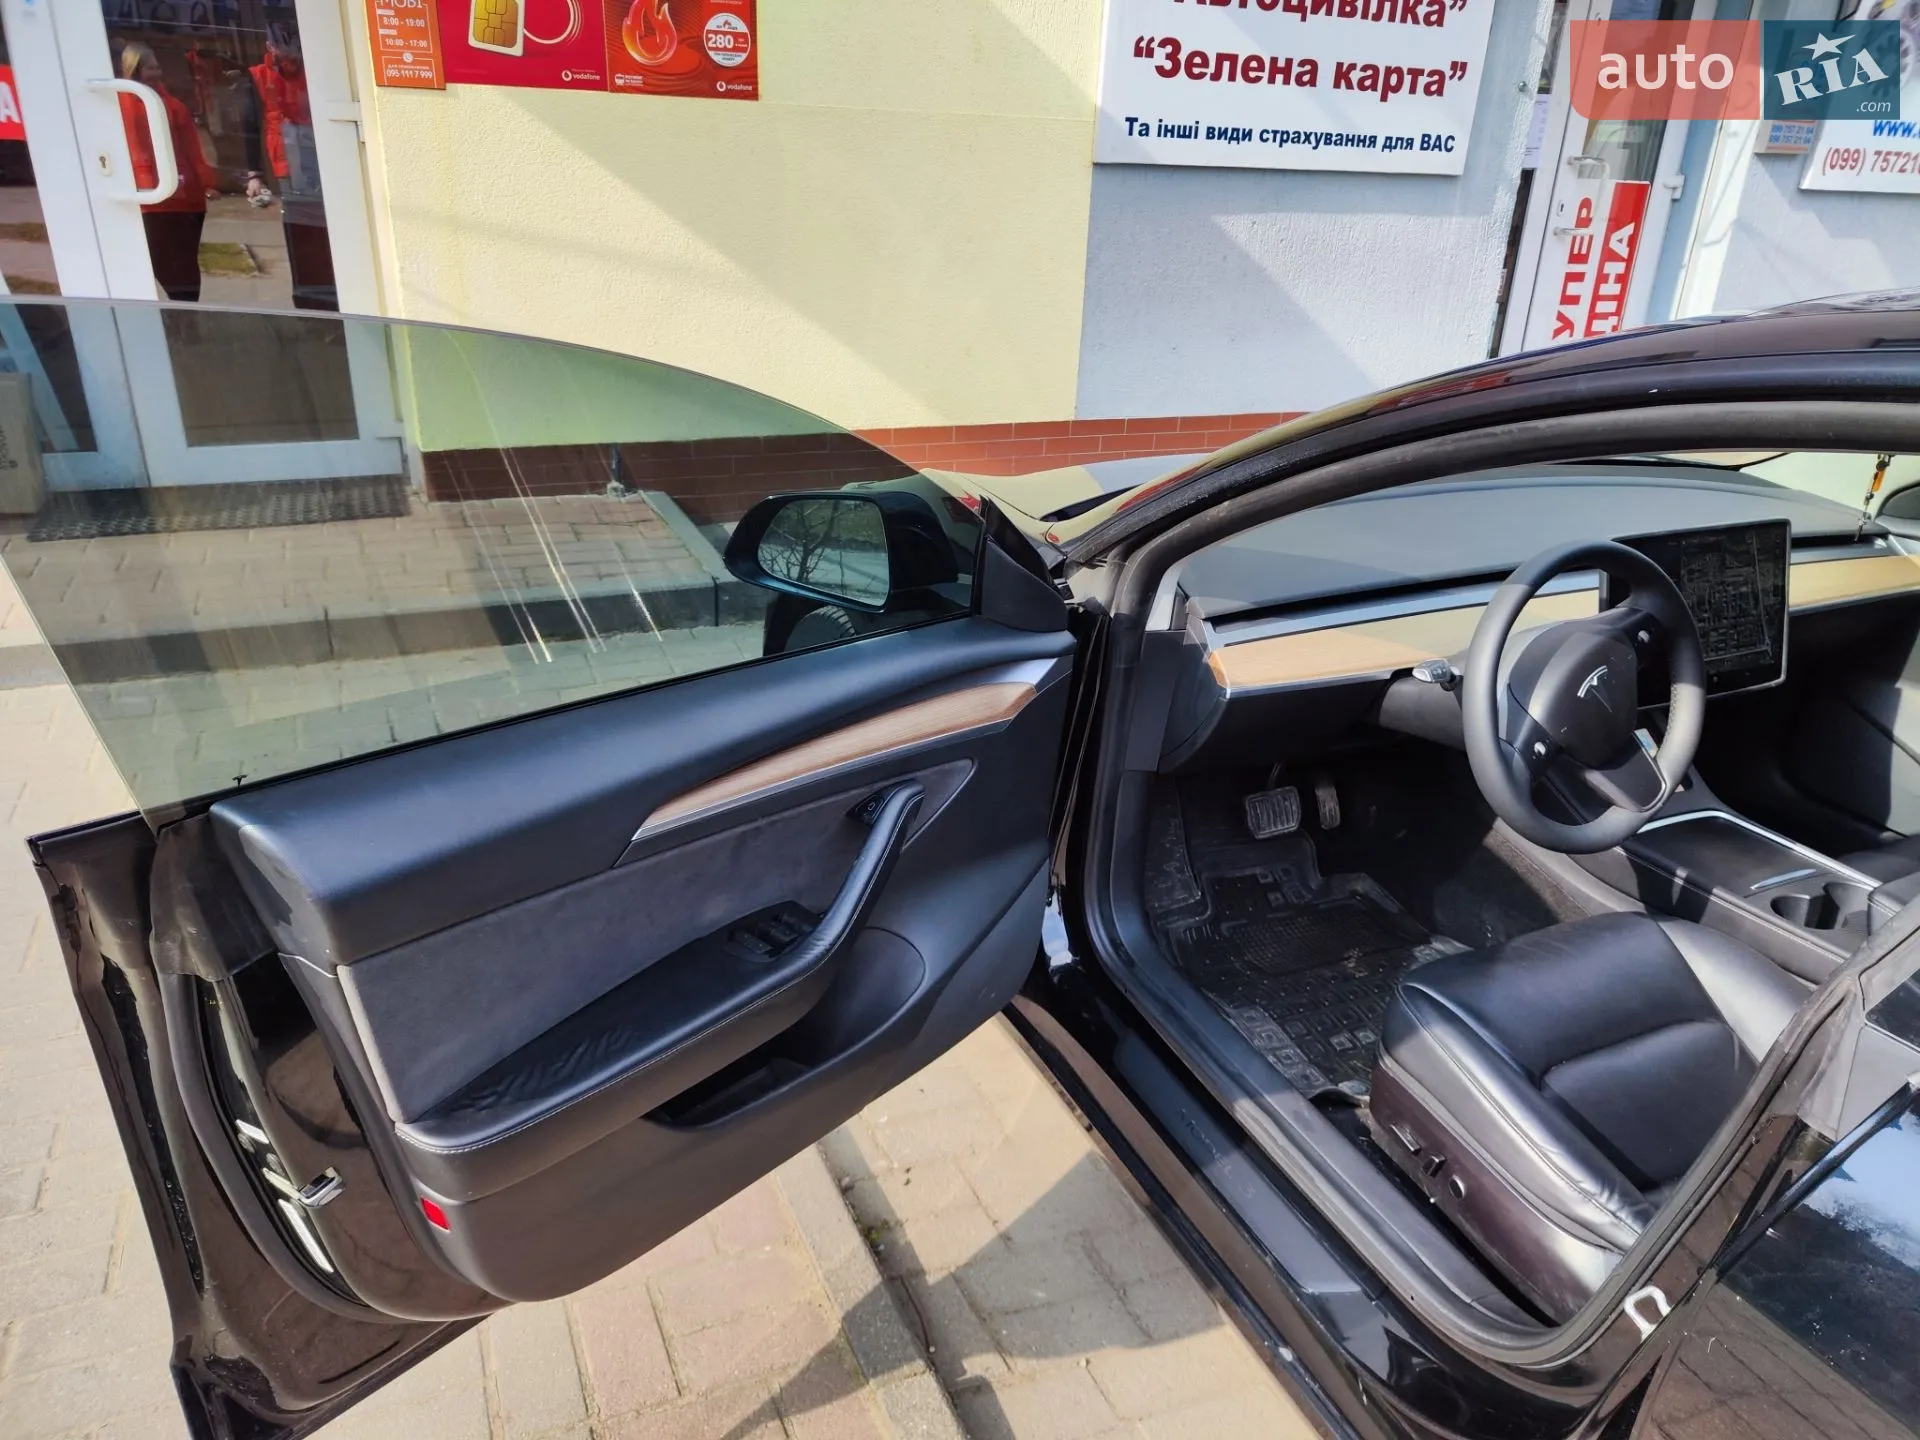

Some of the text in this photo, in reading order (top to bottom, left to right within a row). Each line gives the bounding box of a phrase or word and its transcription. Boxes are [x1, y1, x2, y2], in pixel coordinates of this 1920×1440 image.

[1174, 0, 1468, 28] цивілка”
[707, 33, 734, 49] 280
[573, 73, 600, 81] vodafone
[1133, 35, 1468, 103] “Зелена карта”
[727, 83, 753, 91] vodafone
[1125, 116, 1456, 153] Та інші види страхування для ВАС
[1872, 119, 1920, 139] www.
[1822, 146, 1920, 176] (099) 75721
